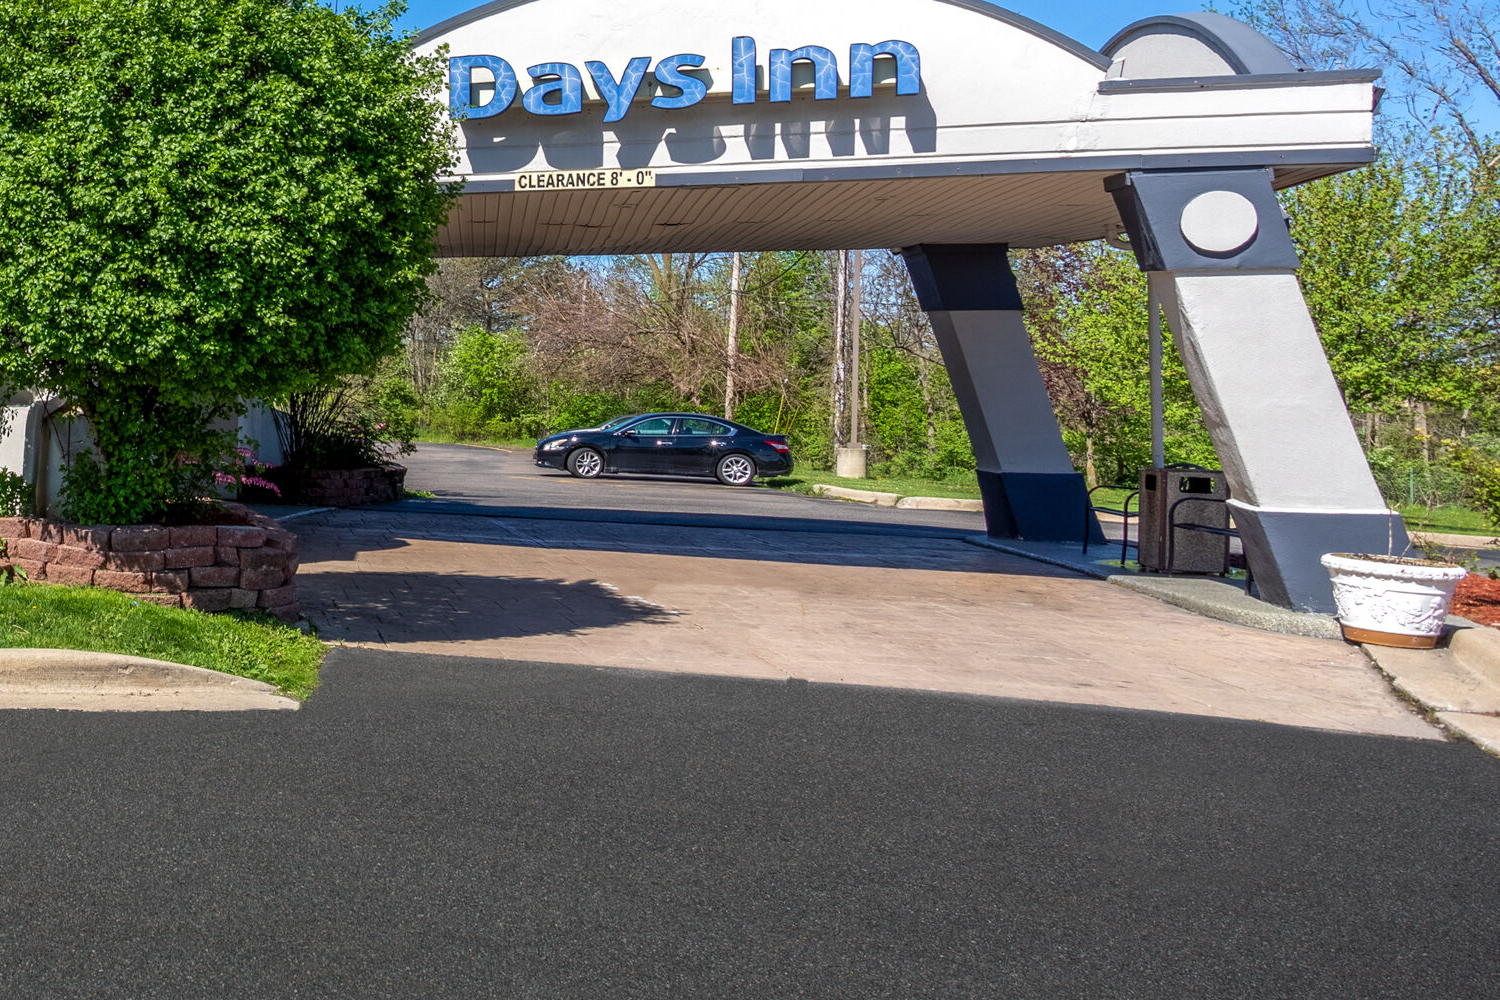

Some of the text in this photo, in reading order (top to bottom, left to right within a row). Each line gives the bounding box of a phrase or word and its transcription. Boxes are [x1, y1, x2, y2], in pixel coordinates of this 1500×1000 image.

[448, 35, 921, 123] Days Inn
[517, 171, 606, 190] CLEARANCE
[610, 172, 624, 186] 8'
